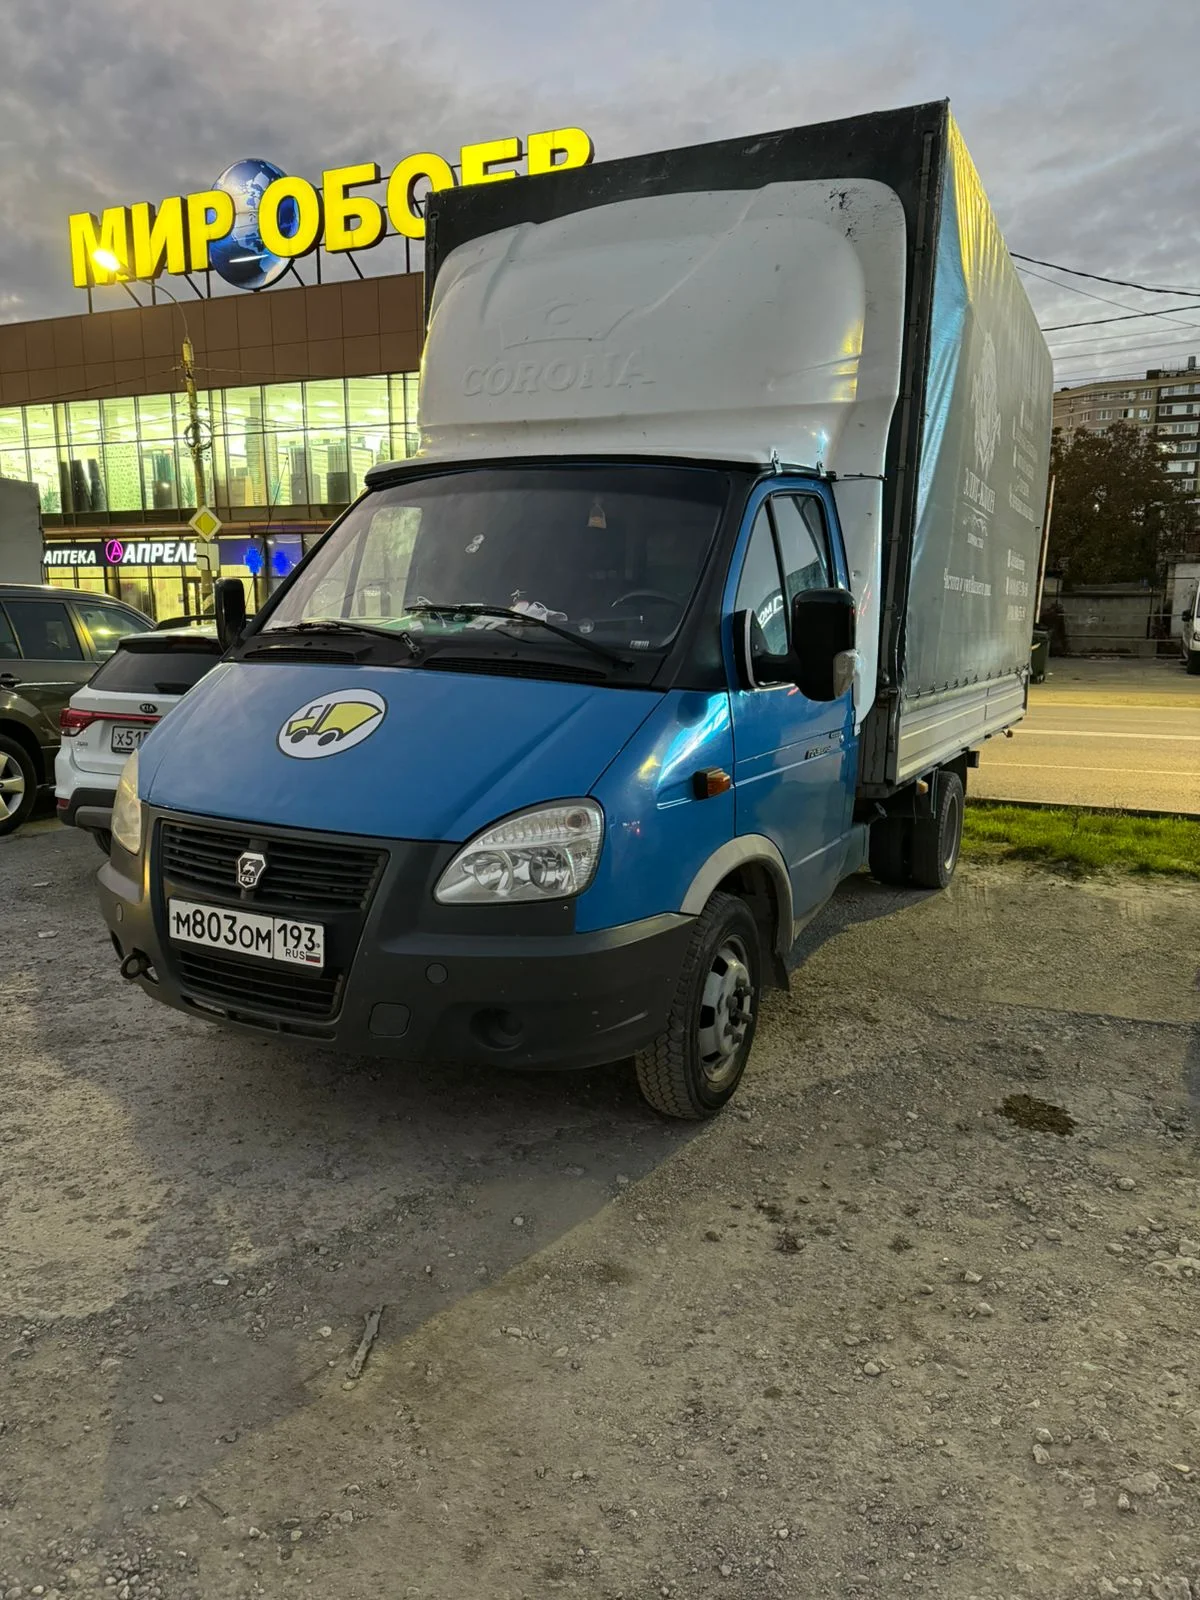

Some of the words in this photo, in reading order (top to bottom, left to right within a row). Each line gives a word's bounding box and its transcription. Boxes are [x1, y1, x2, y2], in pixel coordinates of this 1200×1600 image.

[69, 190, 236, 287] МИР
[462, 351, 656, 397] CORONA
[44, 550, 97, 564] АПТЕКА
[117, 730, 149, 746] Х51
[176, 909, 272, 953] М803ОМ
[277, 923, 316, 951] 193
[285, 948, 305, 960] RUS
